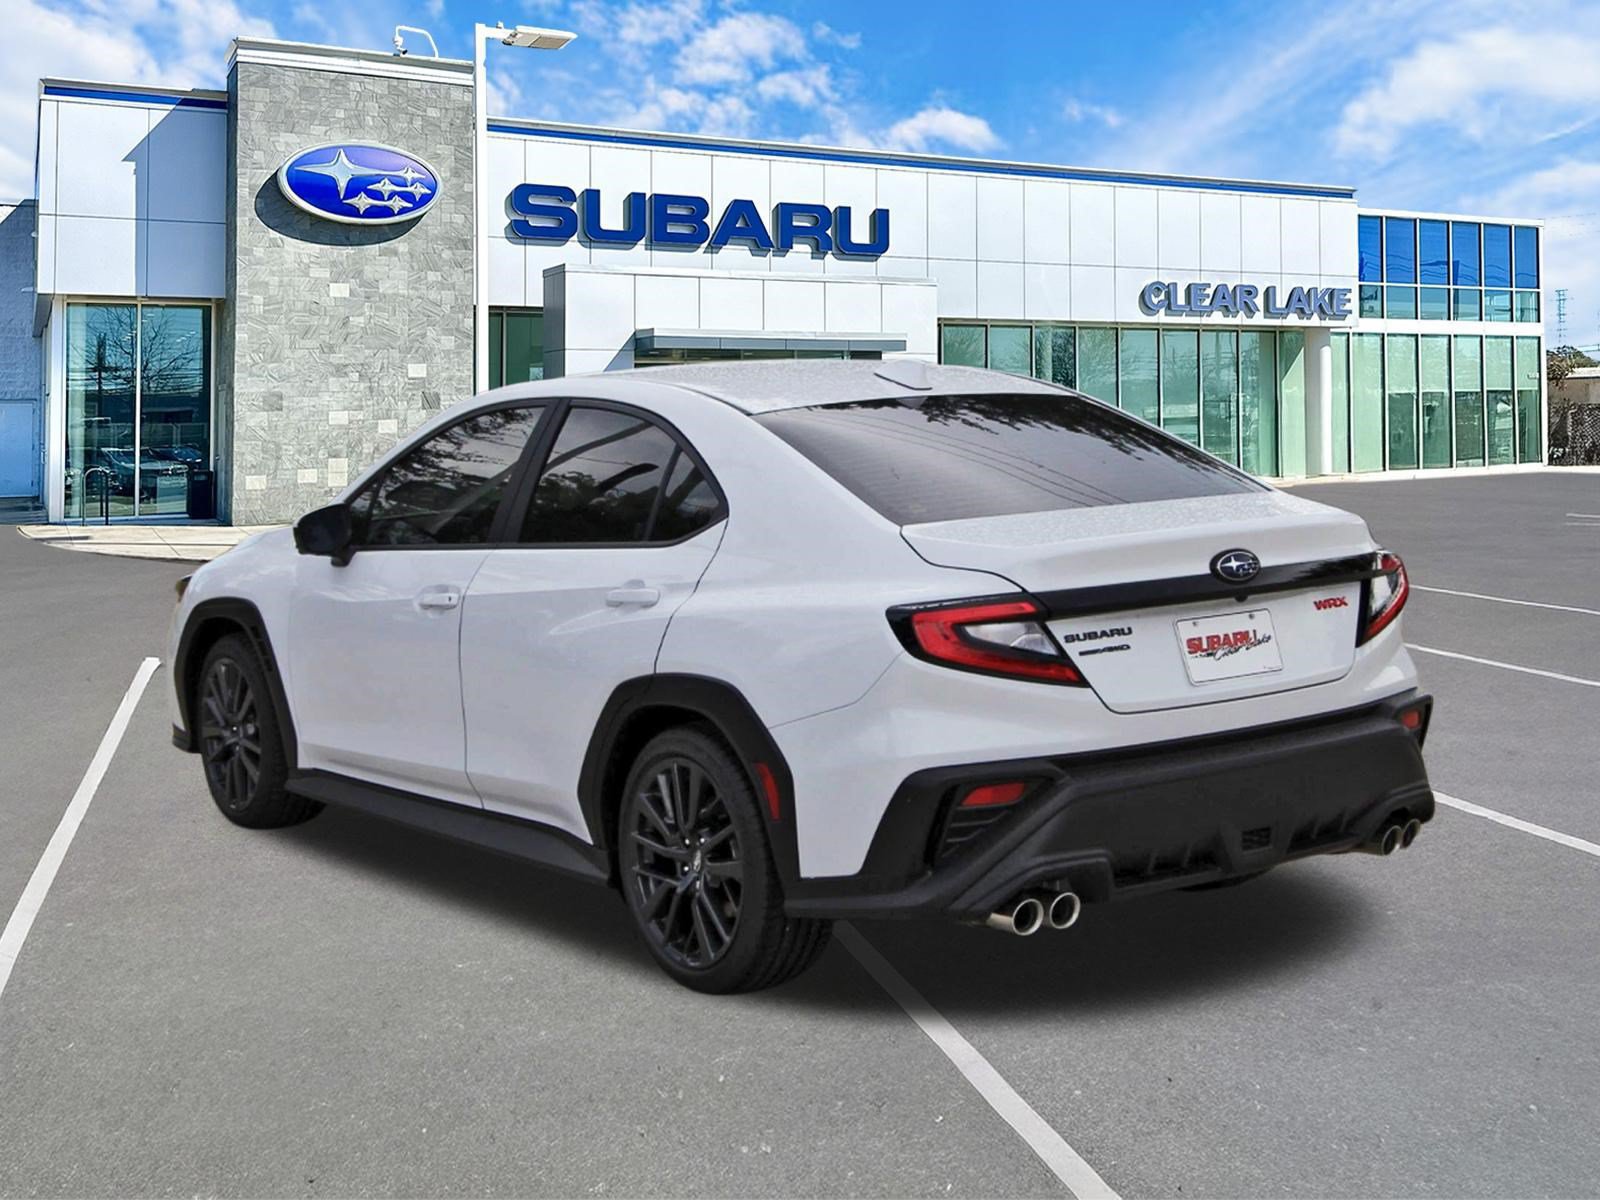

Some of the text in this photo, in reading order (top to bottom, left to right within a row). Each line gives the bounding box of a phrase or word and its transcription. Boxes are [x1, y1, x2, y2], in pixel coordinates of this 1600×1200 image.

[506, 183, 890, 258] SUBARU
[1141, 281, 1352, 319] CLEAR LAKE
[1313, 596, 1348, 610] WRX
[1063, 626, 1132, 643] SUBARU
[1186, 629, 1256, 655] SUBARU
